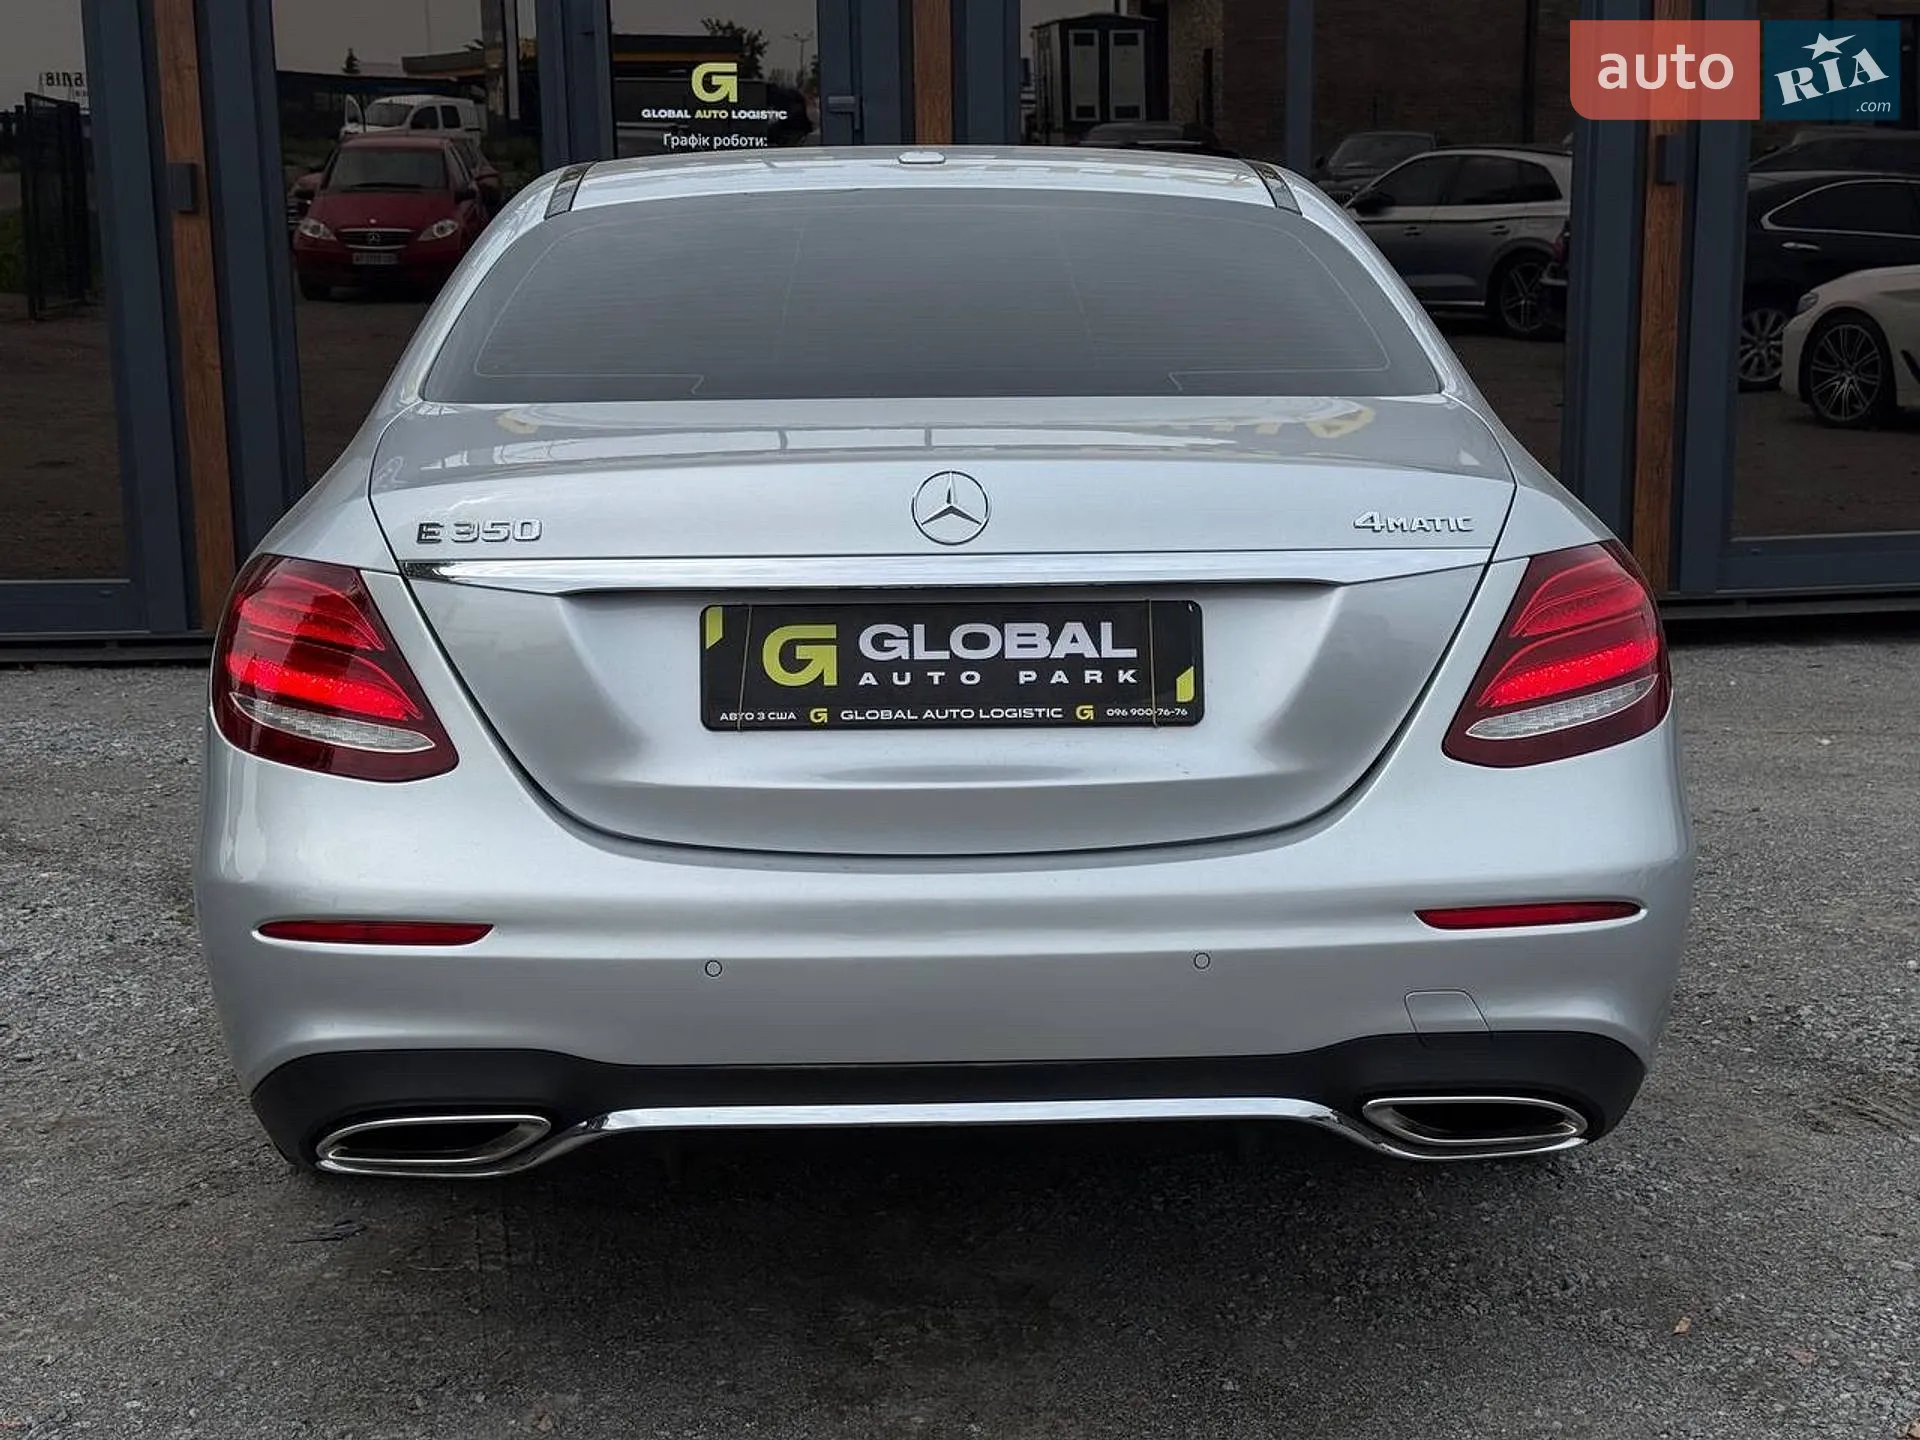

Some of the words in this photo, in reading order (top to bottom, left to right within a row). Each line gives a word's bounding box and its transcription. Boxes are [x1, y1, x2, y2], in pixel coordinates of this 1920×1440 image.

[641, 109, 691, 119] GLOBAL
[695, 109, 728, 120] AUTO
[732, 109, 788, 120] LOGISTIC
[663, 133, 710, 149] Графік
[713, 133, 768, 149] роботи:
[1353, 511, 1474, 533] 4MATIC
[416, 522, 444, 544] E
[451, 520, 542, 543] 350
[859, 621, 1138, 661] GLOBAL
[762, 624, 838, 687] G
[858, 671, 981, 686] AUTO
[1018, 669, 1139, 685] PARK
[720, 711, 755, 721] АВТО
[767, 711, 798, 721] США
[840, 709, 918, 721] GLOBAL
[922, 708, 975, 720] AUTO
[979, 708, 1064, 719] LOGISTIC
[1106, 708, 1128, 717] 096
[1130, 708, 1188, 717] 900-76-76
